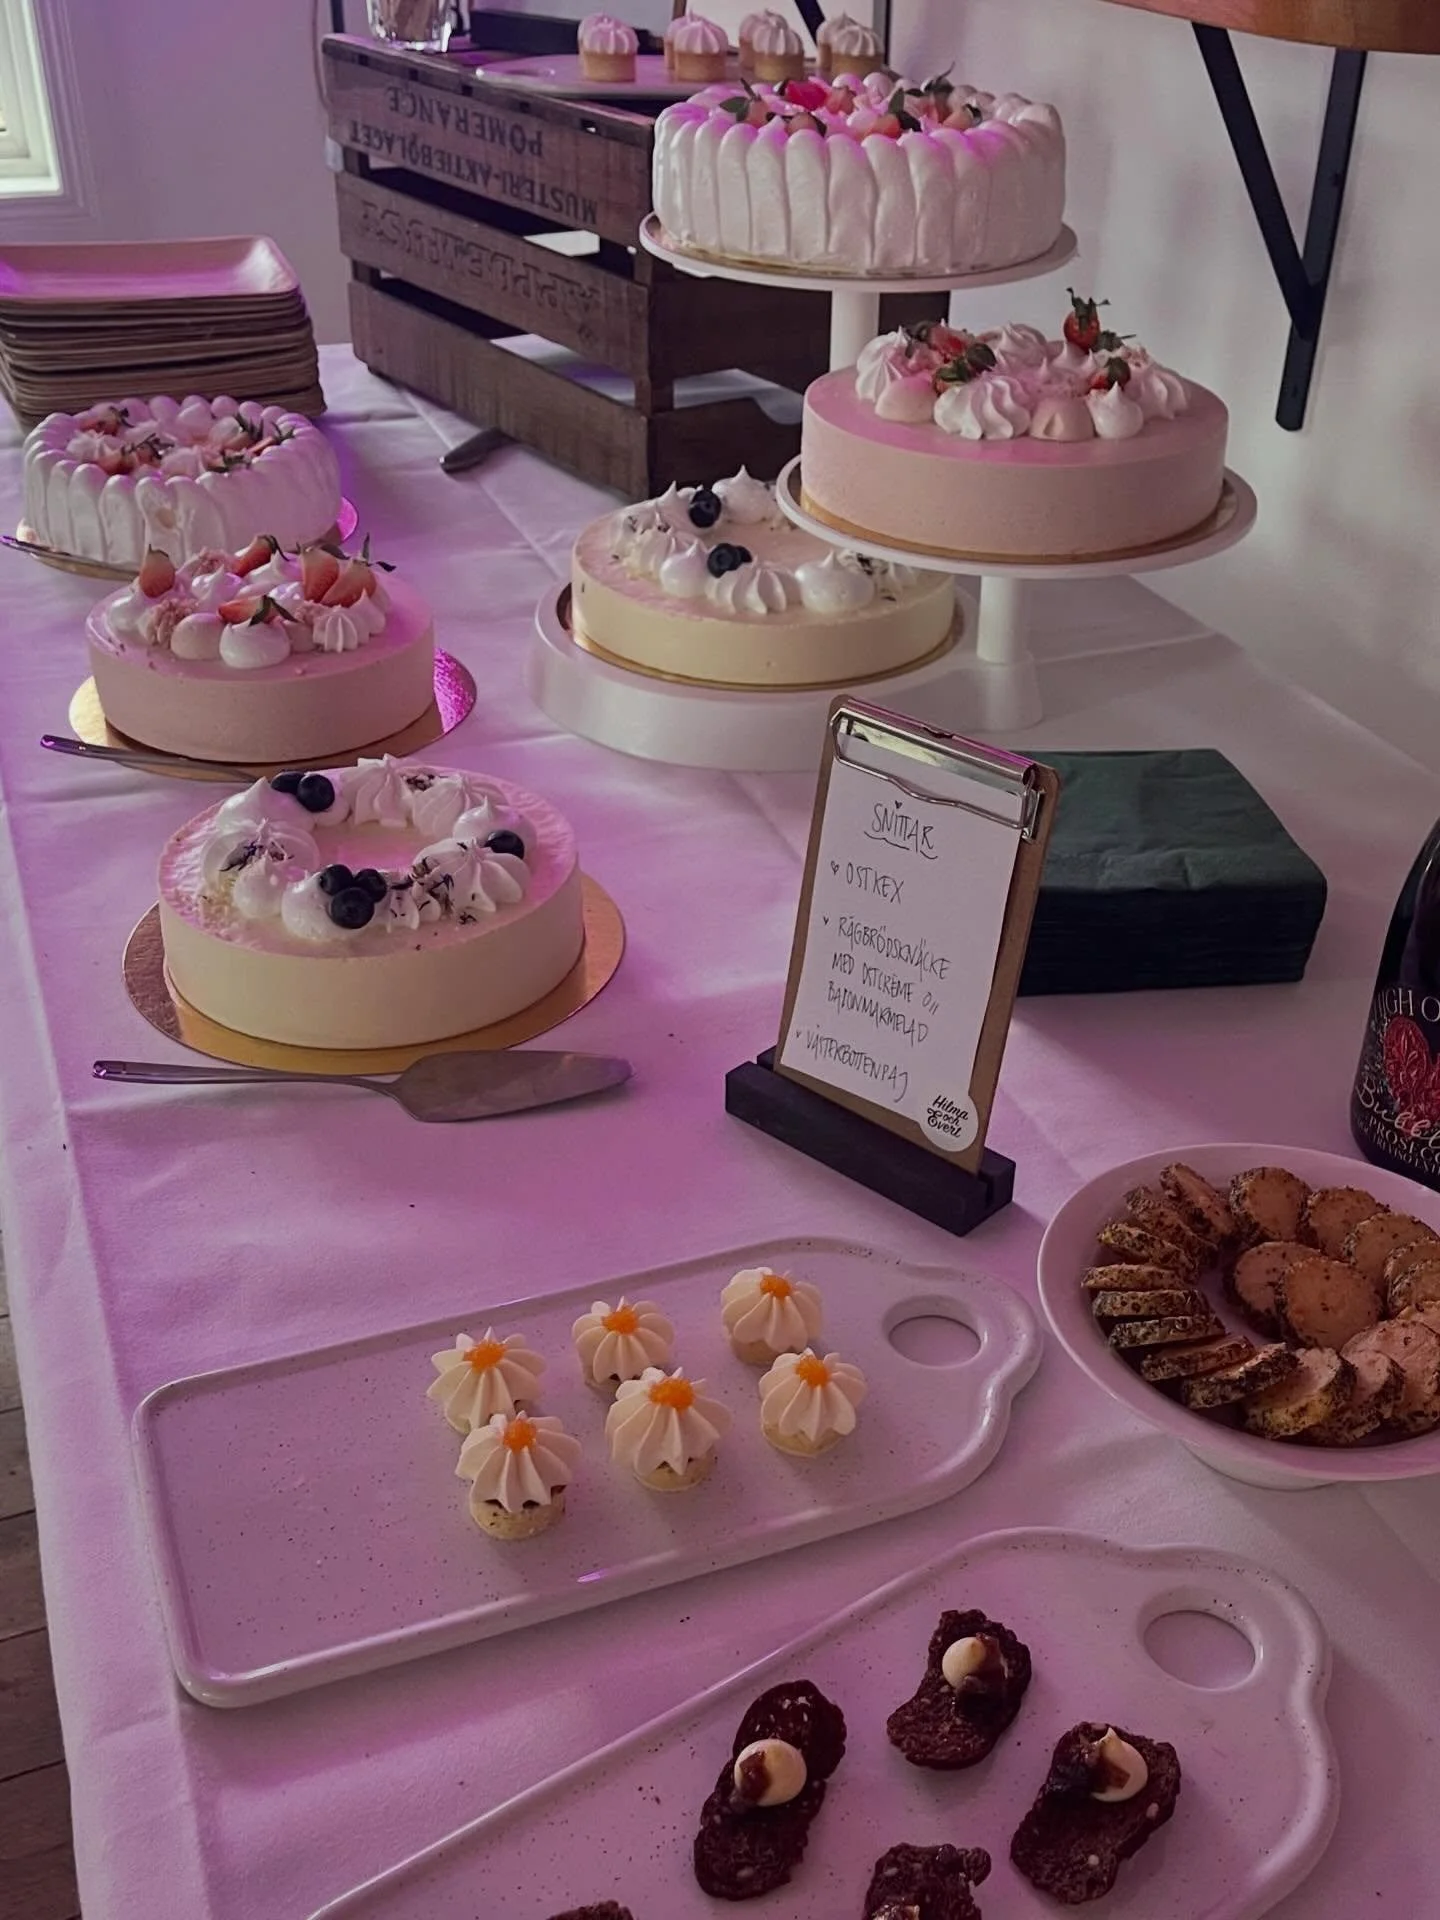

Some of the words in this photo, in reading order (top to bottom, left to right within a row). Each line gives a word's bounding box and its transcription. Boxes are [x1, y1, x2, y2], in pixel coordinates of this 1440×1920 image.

[387, 85, 543, 158] POMERANCE
[871, 801, 934, 852] SNITTAR
[846, 862, 904, 903] OSTKEX
[831, 952, 855, 976] MED
[927, 1107, 962, 1137] Evert
[932, 1095, 968, 1120] Hilma
[943, 1113, 960, 1127] och
